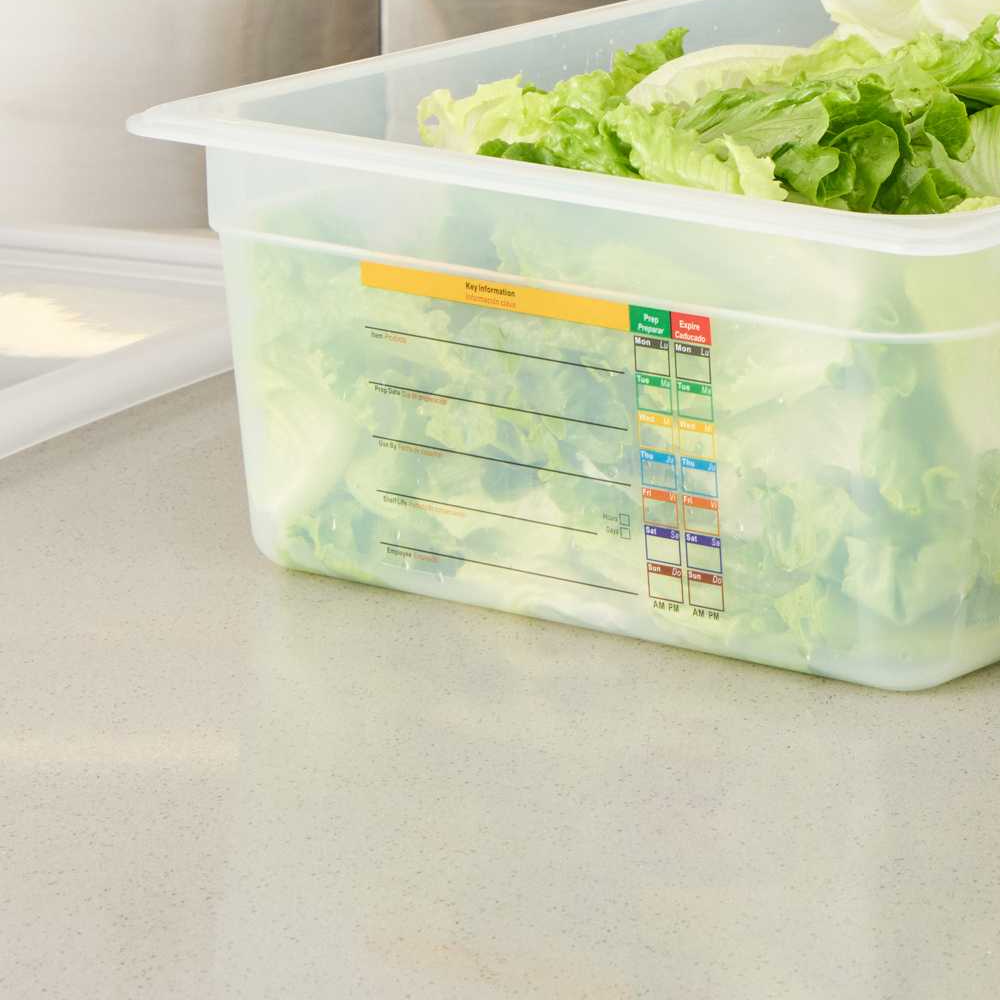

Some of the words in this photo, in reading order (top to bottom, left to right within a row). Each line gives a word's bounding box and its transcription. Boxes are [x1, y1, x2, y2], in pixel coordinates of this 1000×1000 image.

[465, 281, 478, 293] Key
[643, 313, 659, 325] Prep
[638, 323, 665, 335] Preparar
[679, 319, 700, 331] Expire
[635, 337, 651, 346] Mon
[675, 344, 692, 353] Mon
[637, 374, 650, 384] Tue
[677, 382, 690, 391] Tue
[645, 526, 657, 535] Sat
[686, 533, 698, 543] Sat
[648, 563, 661, 572] Sun
[688, 571, 701, 580] Sun
[653, 600, 665, 610] AM
[668, 604, 680, 613] PM
[693, 607, 705, 617] AM
[708, 611, 720, 621] PM
